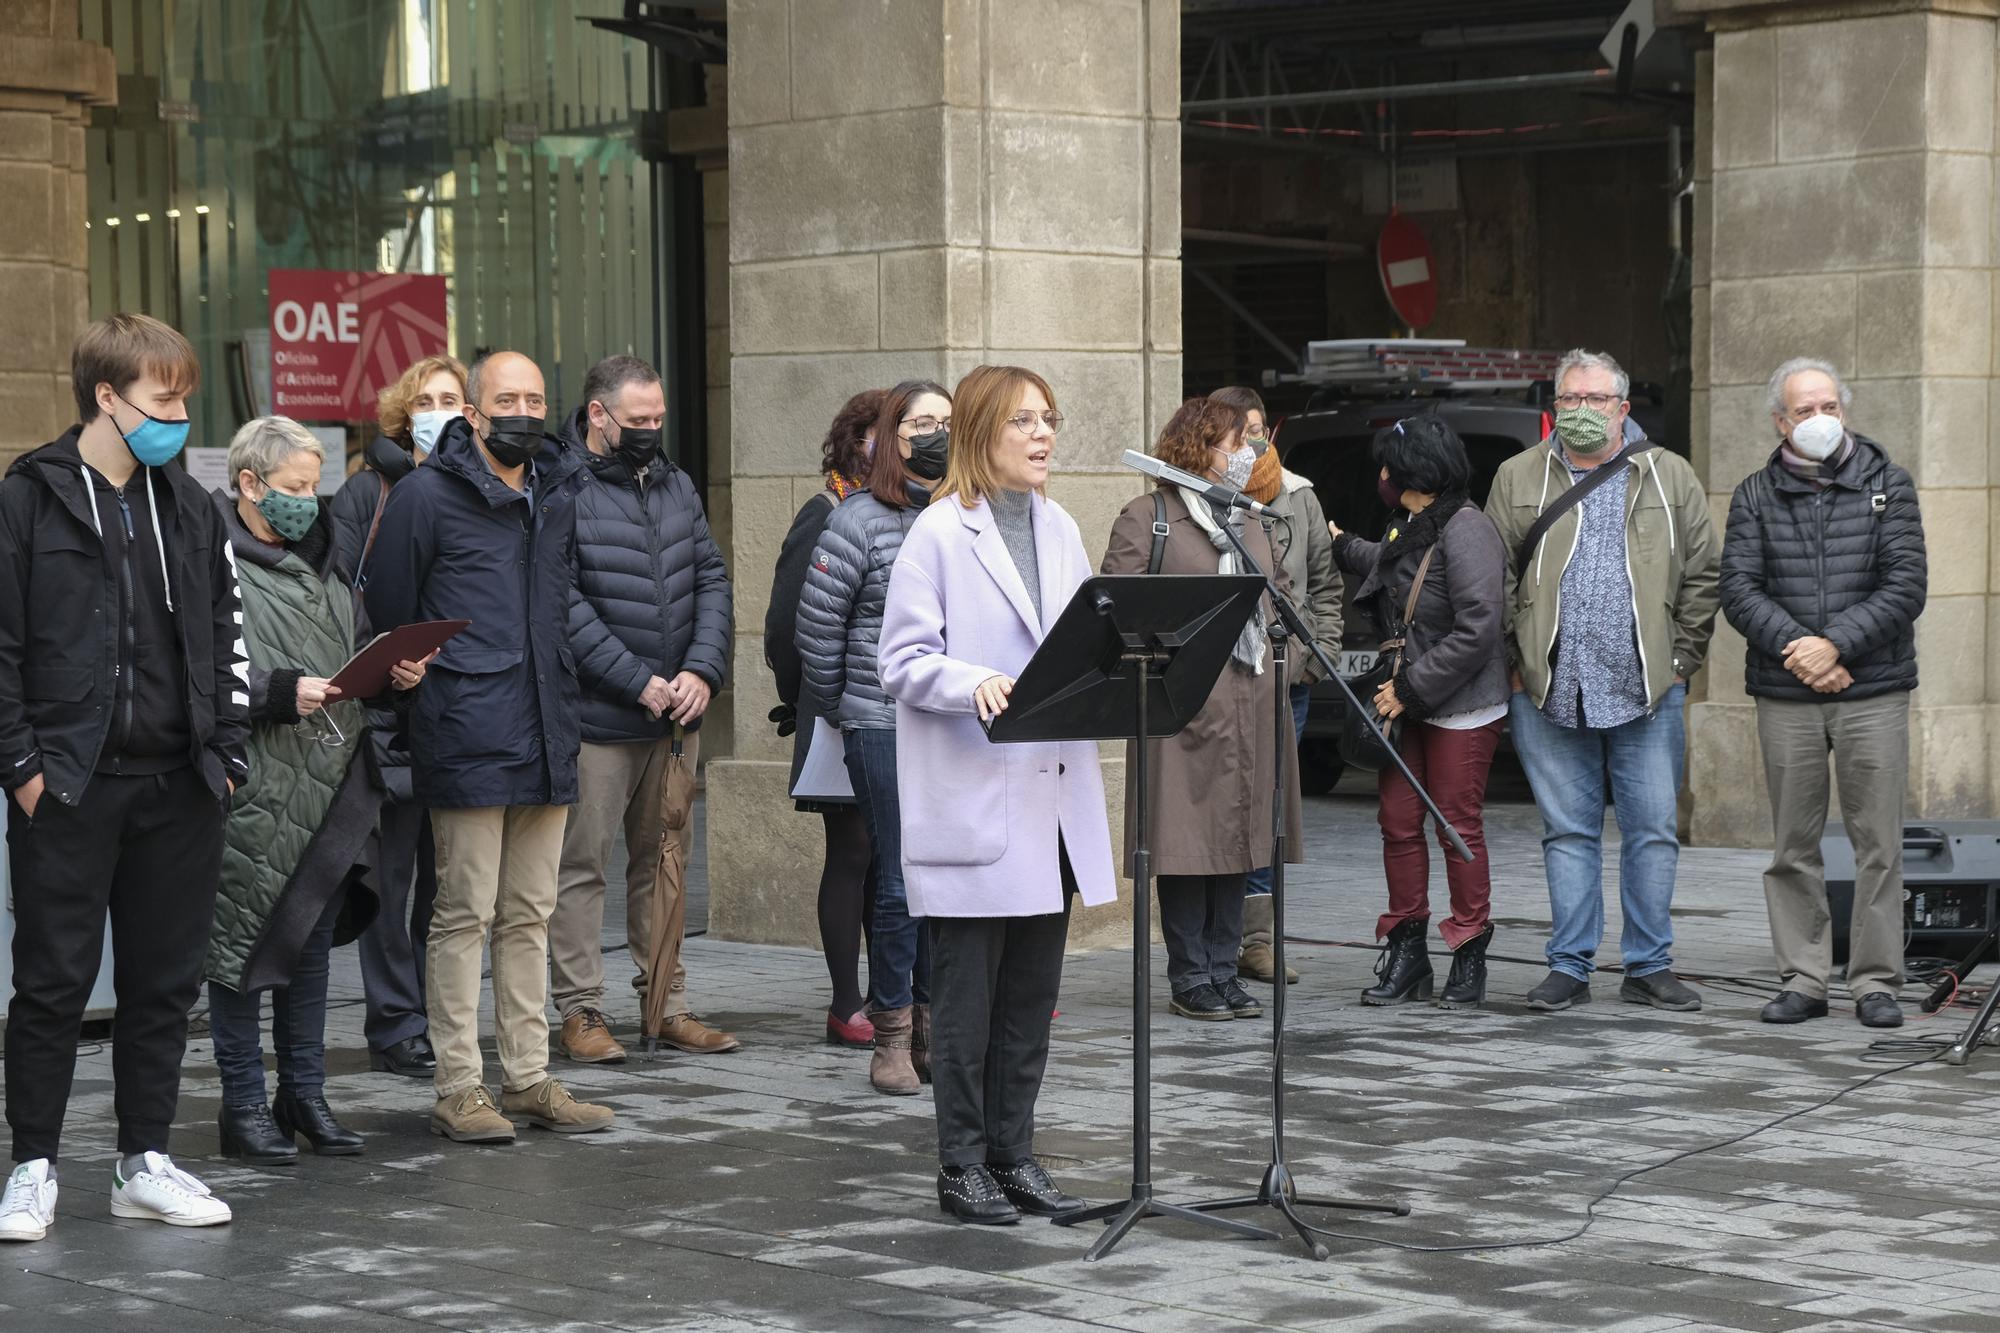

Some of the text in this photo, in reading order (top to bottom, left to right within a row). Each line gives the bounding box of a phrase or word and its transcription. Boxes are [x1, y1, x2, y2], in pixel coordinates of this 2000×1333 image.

[274, 301, 360, 343] OAE
[275, 351, 319, 366] Oficina
[276, 371, 338, 386] d'Activitat
